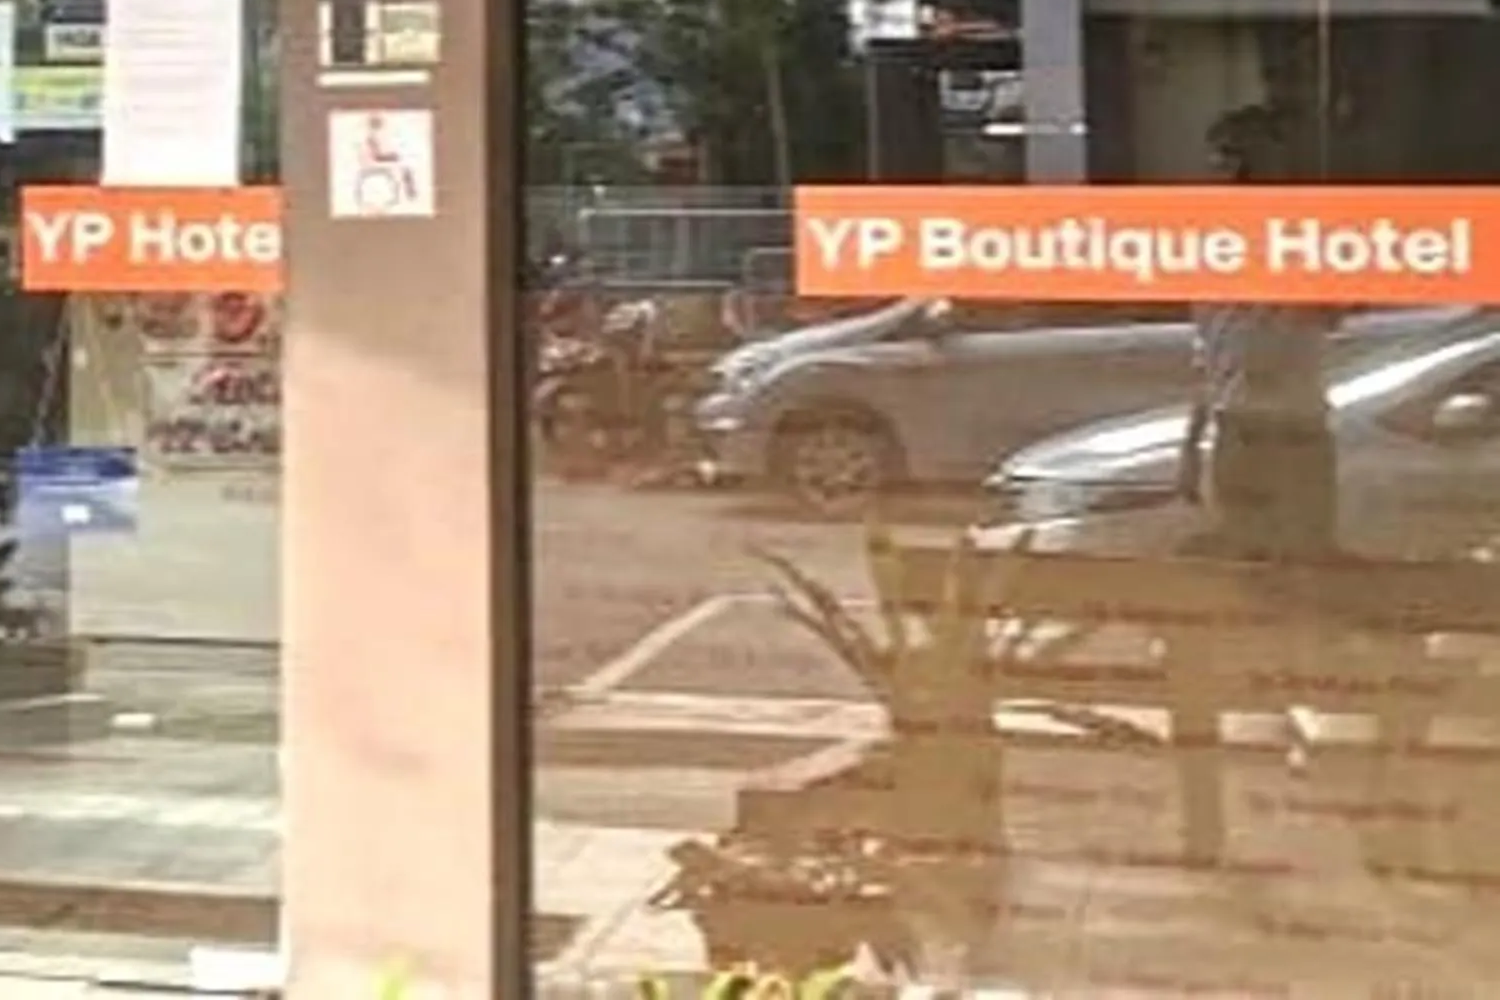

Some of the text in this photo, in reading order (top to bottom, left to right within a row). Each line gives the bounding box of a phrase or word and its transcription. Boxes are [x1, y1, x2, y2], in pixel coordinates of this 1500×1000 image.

[24, 206, 281, 264] YP Hote
[806, 216, 1473, 284] YP Boutique Hotel
